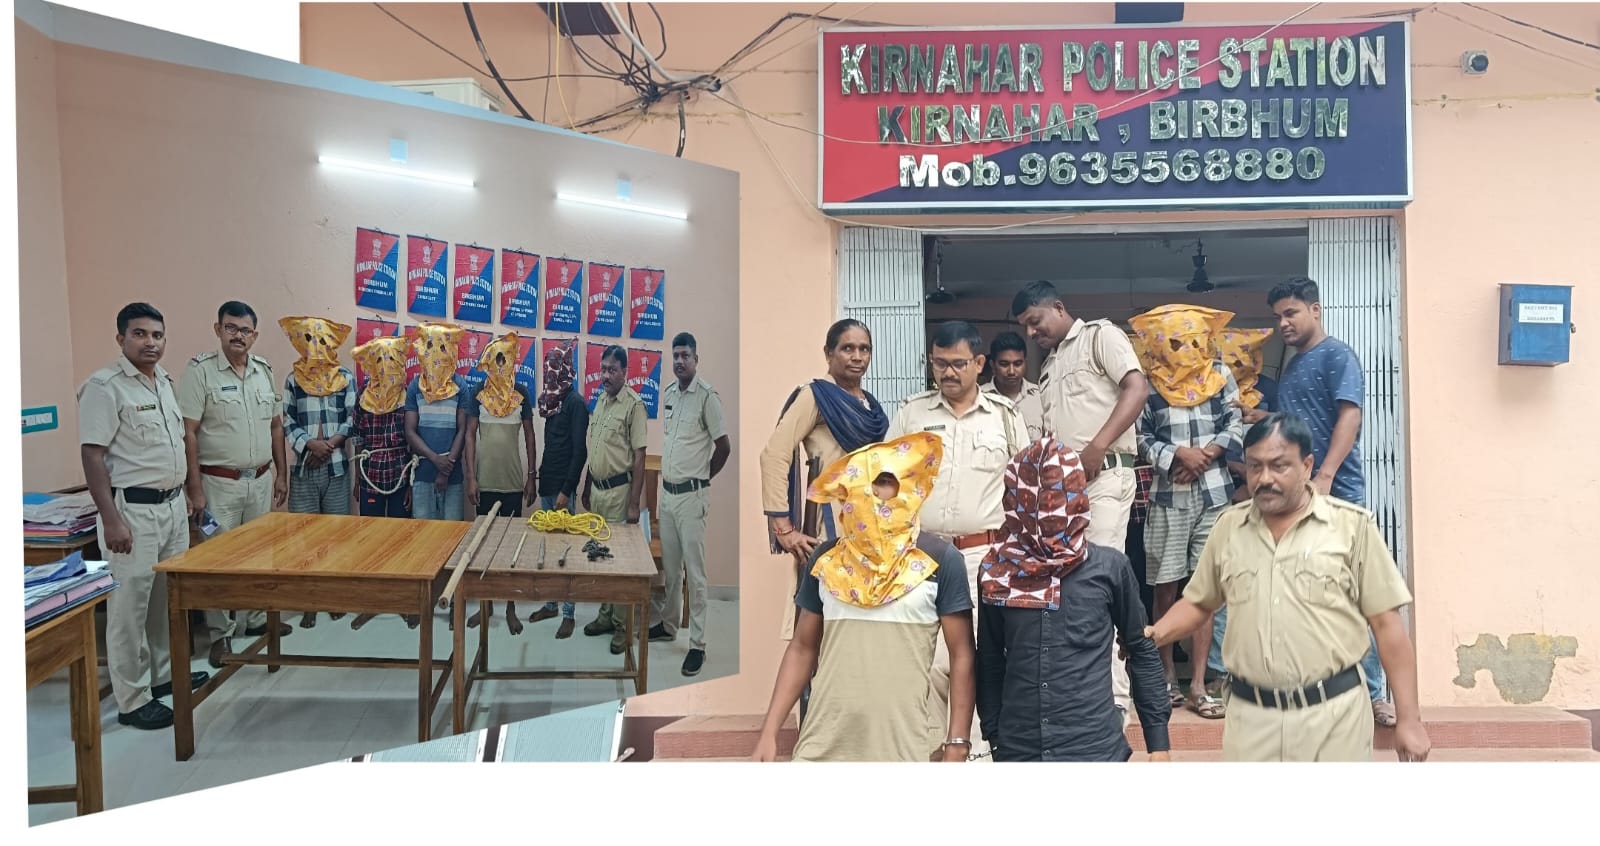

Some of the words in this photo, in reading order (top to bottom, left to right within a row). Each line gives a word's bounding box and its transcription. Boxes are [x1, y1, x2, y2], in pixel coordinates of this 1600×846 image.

[840, 43, 1045, 95] KIRNAHAR
[1062, 40, 1202, 92] POLICE
[1218, 36, 1387, 89] STATION
[878, 103, 1101, 144] KIRNAHAR
[1149, 98, 1349, 140] BIRBHUM
[899, 146, 1326, 187] Mob.9635568880
